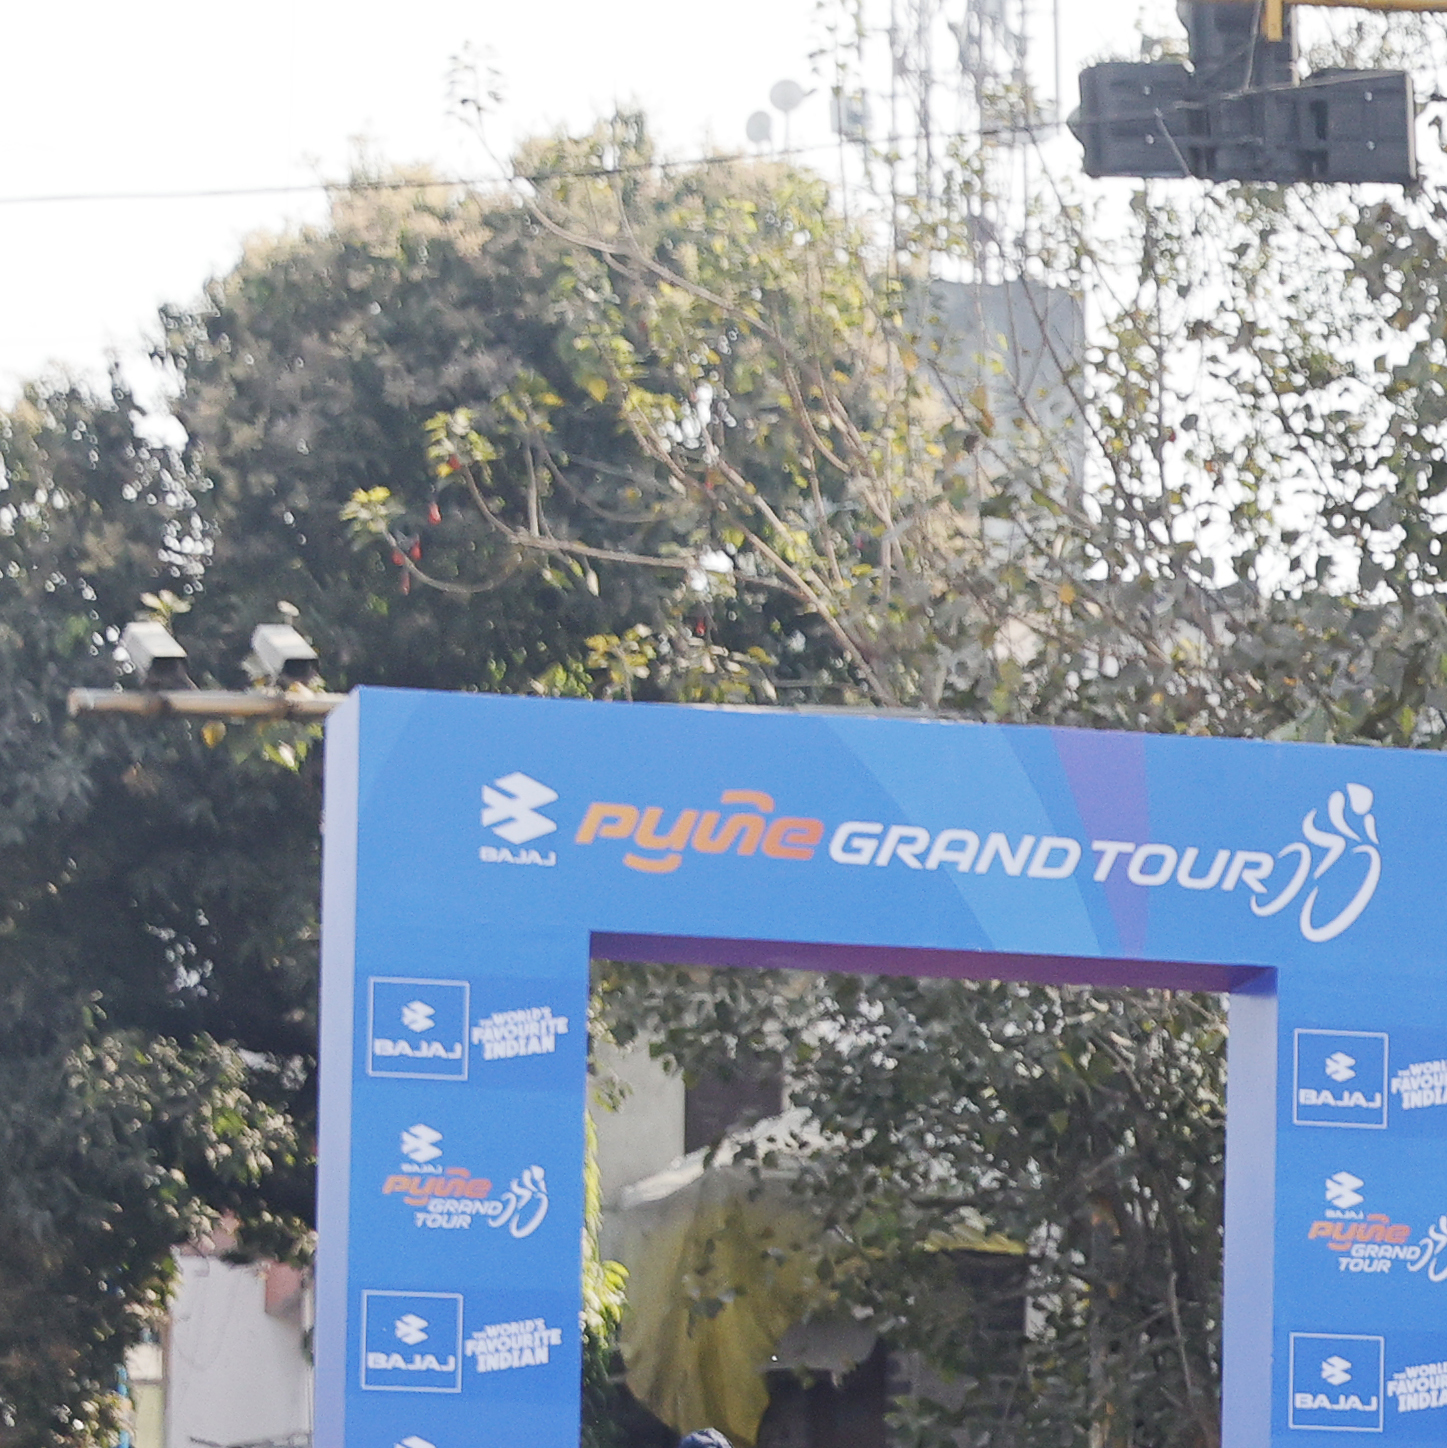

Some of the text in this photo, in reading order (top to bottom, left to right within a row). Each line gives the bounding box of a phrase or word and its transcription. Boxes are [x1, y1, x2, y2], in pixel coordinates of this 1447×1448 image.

[479, 846, 557, 867] BAJAJ
[828, 821, 1082, 880] GRAND
[1090, 838, 1275, 894] TOUR
[373, 1038, 463, 1060] BAJAJ
[1299, 1088, 1382, 1109] BAJAJ
[427, 1198, 504, 1216] GRAND
[413, 1211, 472, 1230] TOUR
[1350, 1244, 1421, 1260] GRAND
[1338, 1257, 1391, 1273] TOUR
[367, 1352, 456, 1372] BAJAJ
[476, 1346, 549, 1374] INDIAN
[1294, 1393, 1378, 1412] BAJAJ
